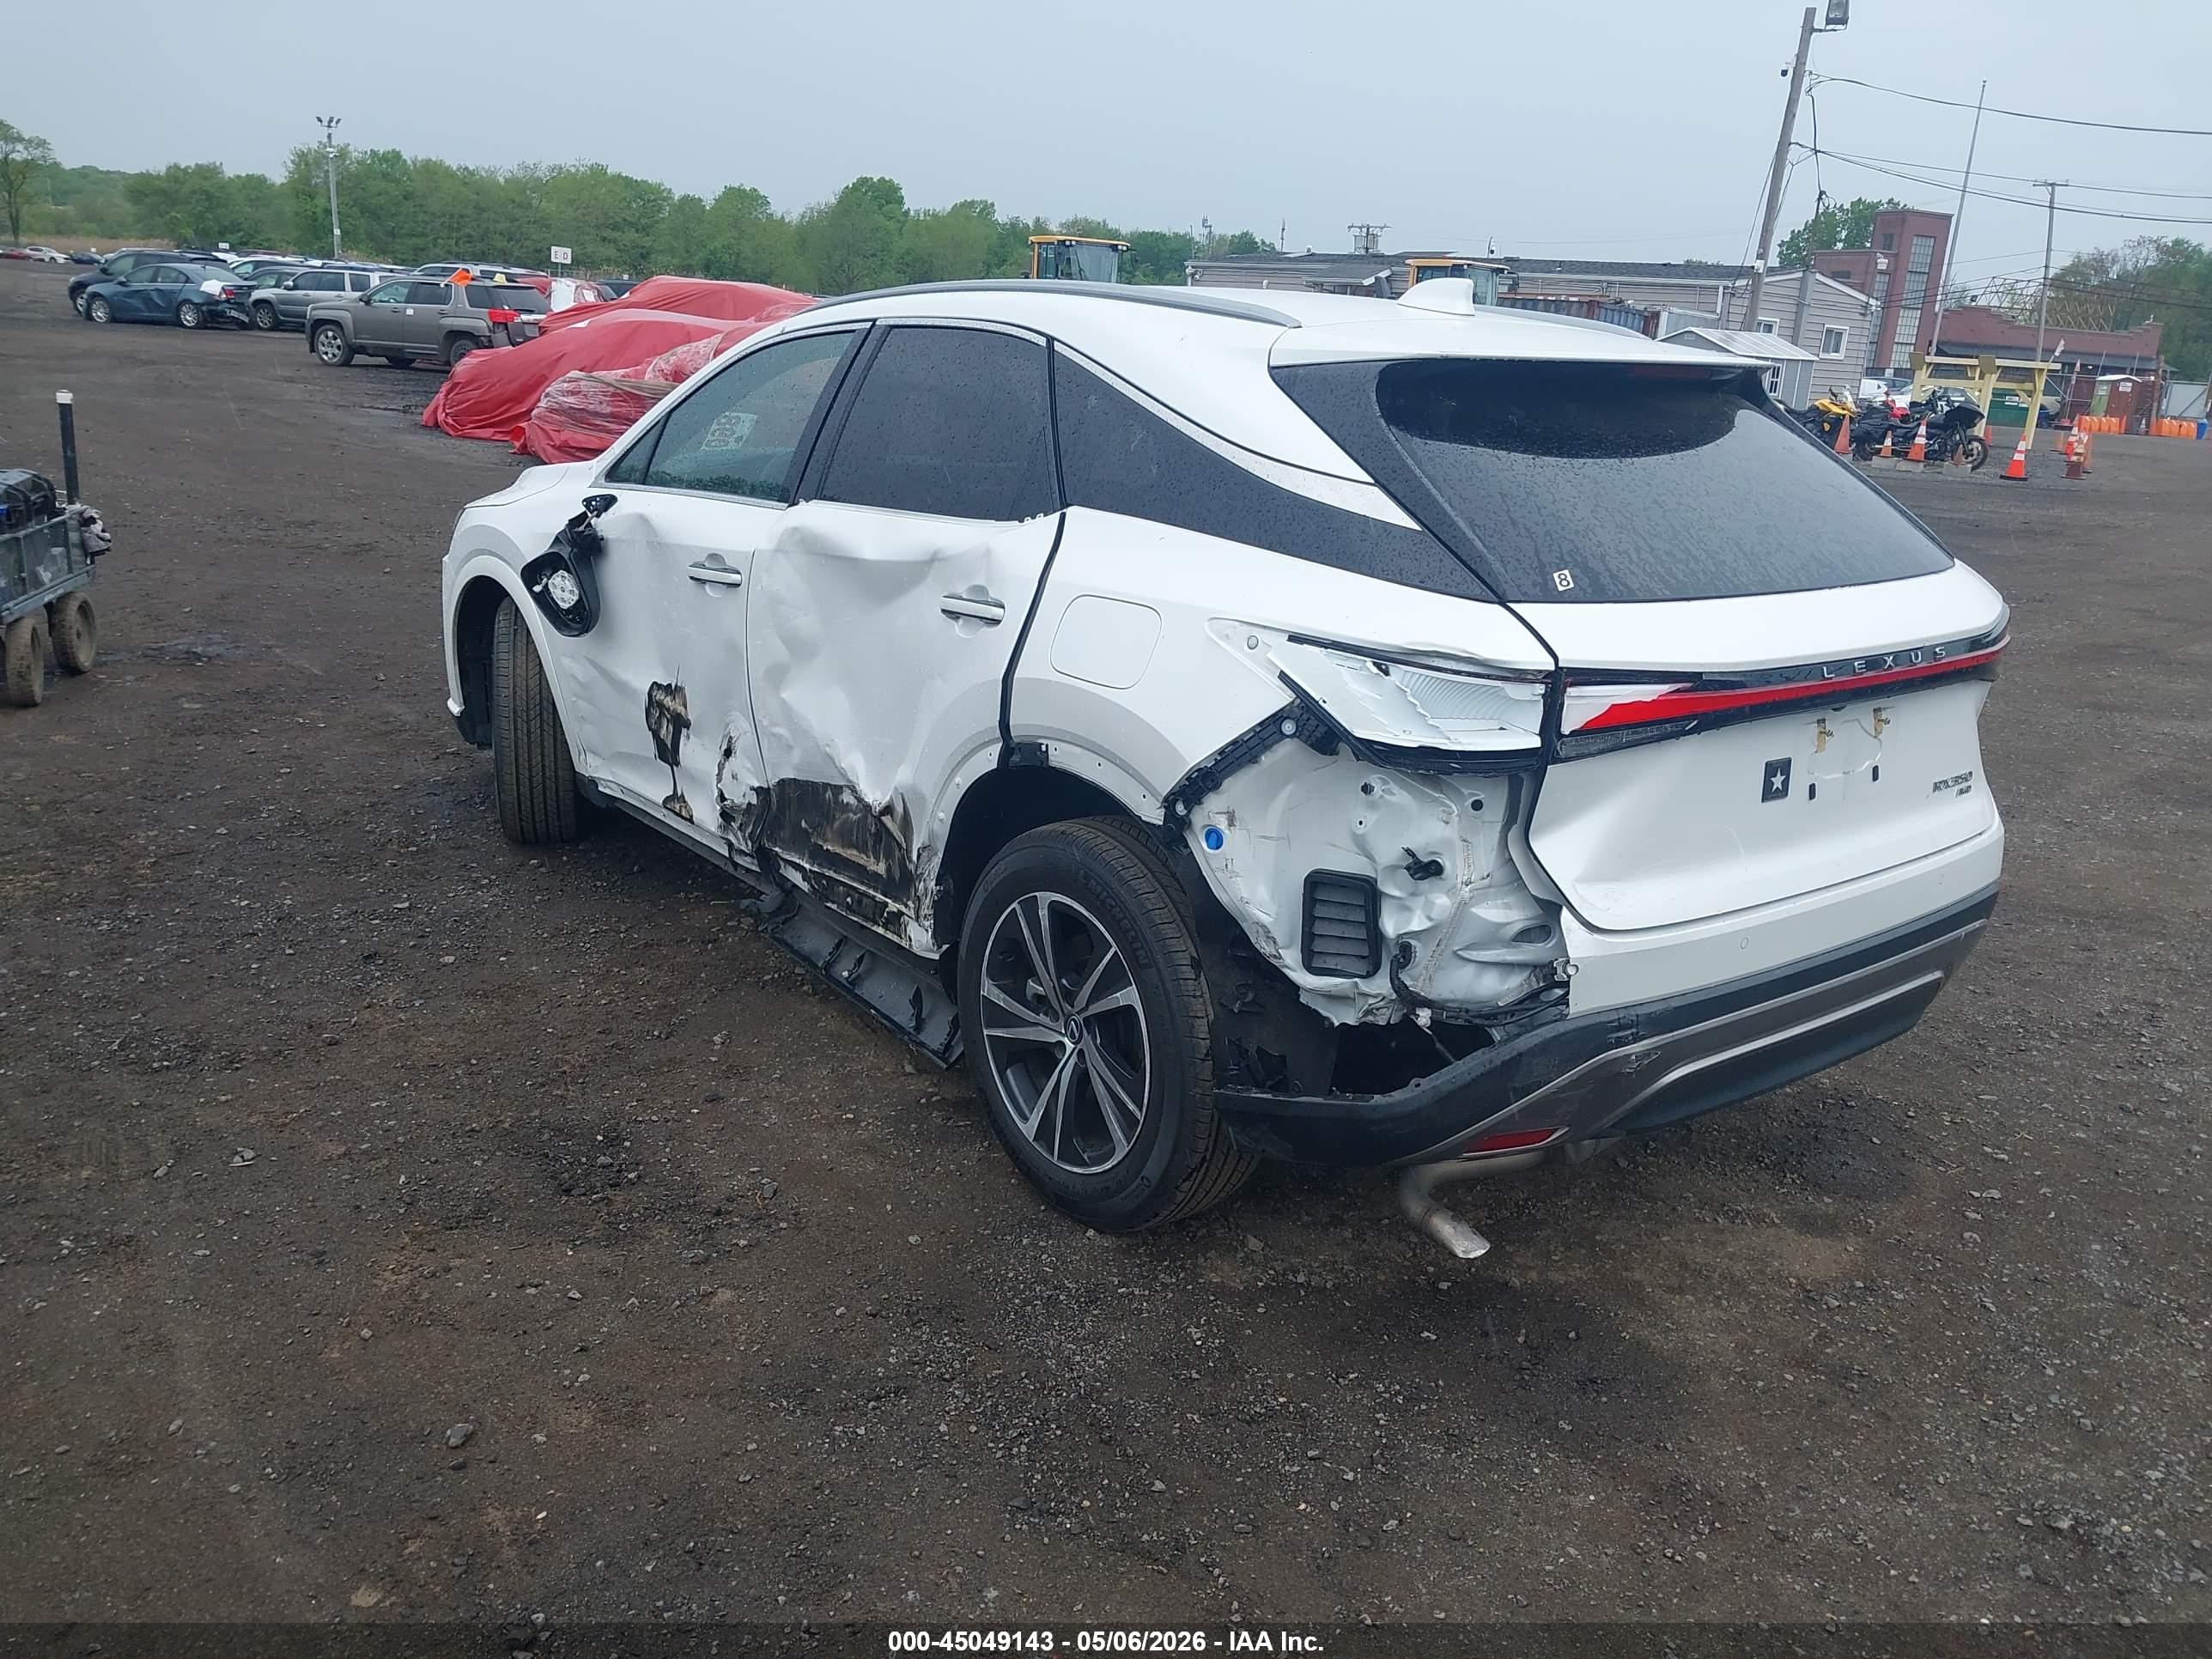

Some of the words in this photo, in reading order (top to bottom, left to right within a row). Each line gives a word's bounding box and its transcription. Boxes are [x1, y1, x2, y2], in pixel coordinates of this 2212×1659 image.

[554, 250, 559, 258] E
[1558, 573, 1571, 587] 8
[1822, 647, 1946, 678] LEXUS
